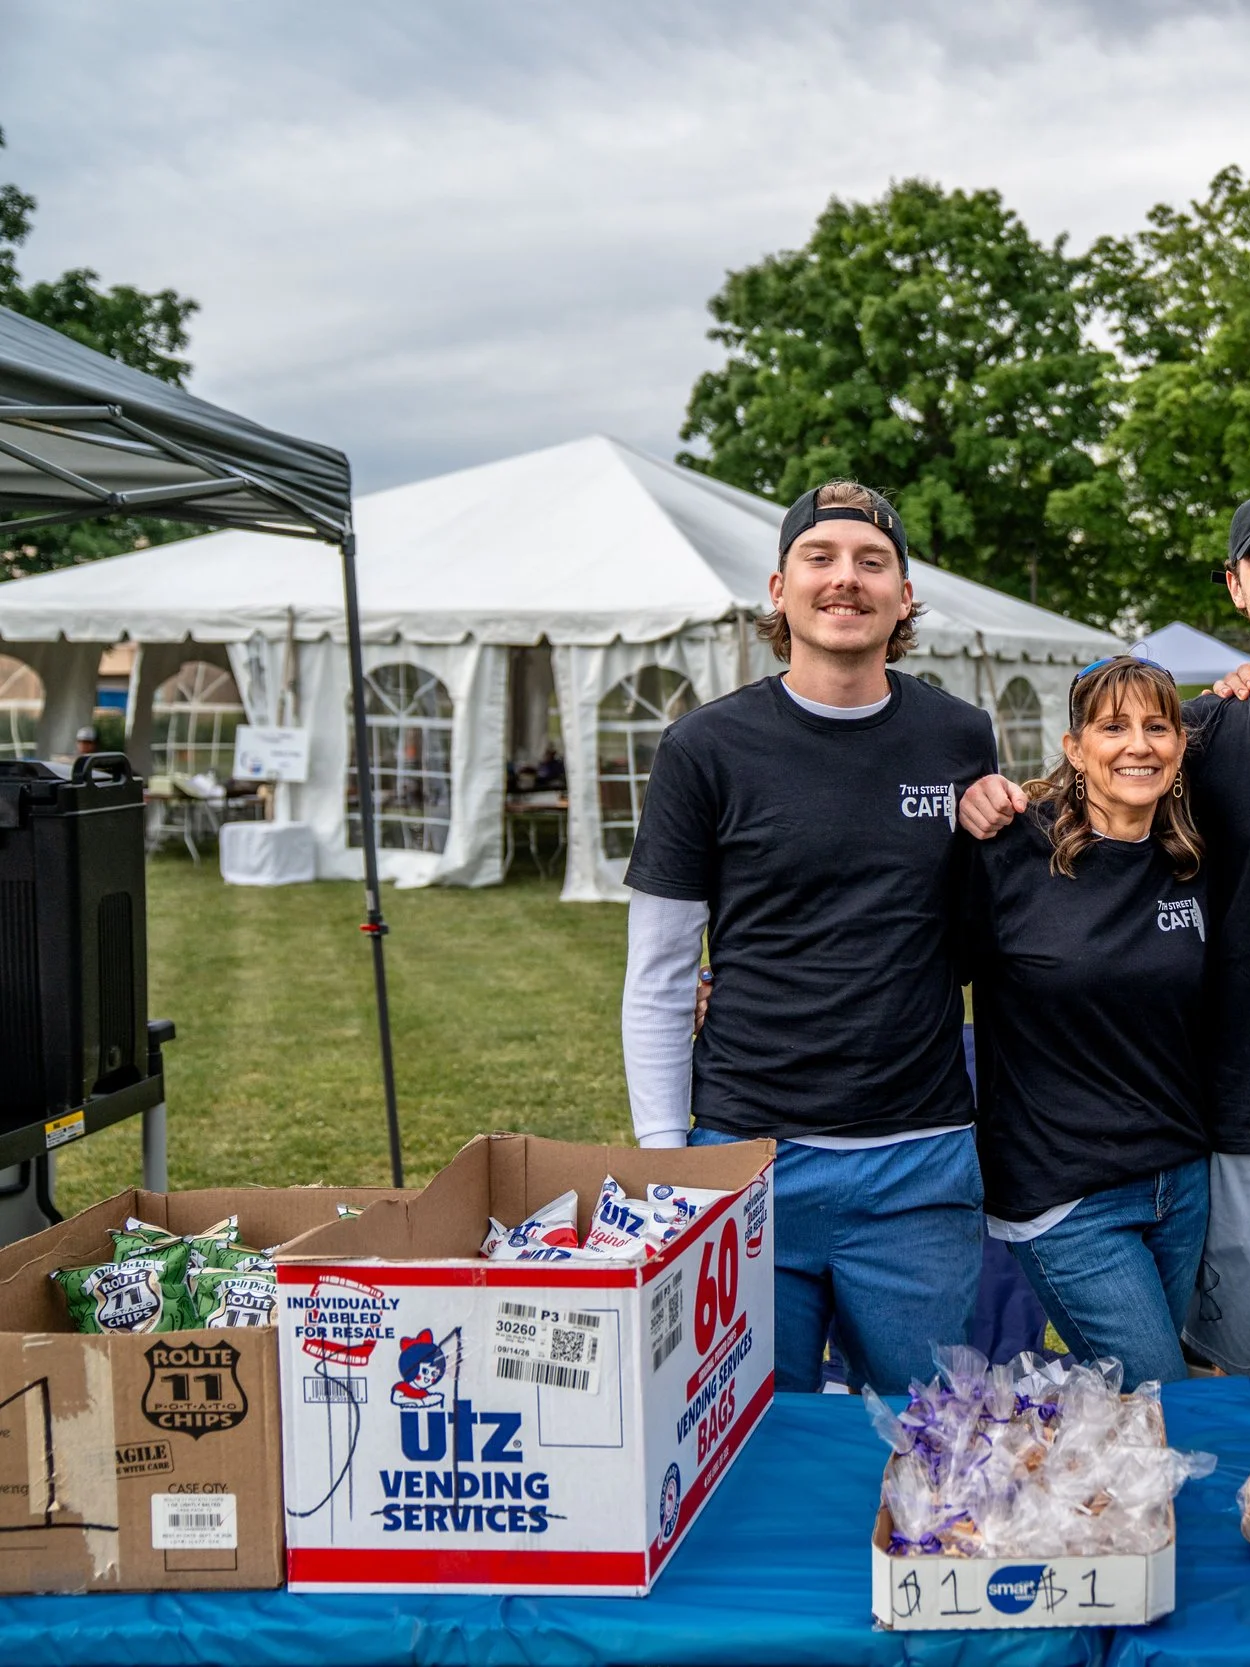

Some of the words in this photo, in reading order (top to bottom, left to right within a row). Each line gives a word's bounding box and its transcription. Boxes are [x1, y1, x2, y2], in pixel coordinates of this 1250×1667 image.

[899, 784, 919, 795] 7TH
[920, 785, 948, 794] STREET
[901, 796, 952, 817] CAFE
[1157, 900, 1168, 911] 7TH
[1168, 899, 1192, 910] STREET
[1157, 909, 1200, 932] CAFE
[94, 1264, 117, 1280] Dill
[117, 1261, 152, 1270] Pickle
[102, 1271, 147, 1293] ROUTE
[224, 1280, 248, 1289] Dill
[694, 1216, 739, 1357] 60
[111, 1285, 143, 1311] 11
[226, 1294, 272, 1310] ROUTE
[287, 1297, 400, 1310] INDIVIDUALLY
[107, 1308, 153, 1328] CHIPS
[308, 1312, 381, 1324] LABELED
[541, 1309, 560, 1323] P3
[295, 1326, 328, 1338] FOR
[333, 1327, 395, 1339] RESALE
[496, 1320, 537, 1337] 30260
[152, 1349, 233, 1366] ROUTE
[160, 1373, 223, 1401] 11
[677, 1373, 717, 1445] VENDING
[719, 1326, 753, 1391] SERVICES
[158, 1412, 233, 1428] CHIPS
[697, 1376, 736, 1467] BAGS
[123, 1465, 145, 1473] WITH
[147, 1461, 170, 1470] CARE
[168, 1482, 200, 1494] CASE
[202, 1482, 229, 1494] QTY:
[379, 1470, 550, 1500] VENDING
[382, 1503, 549, 1534] SERVICES
[988, 1580, 1036, 1596] smart
